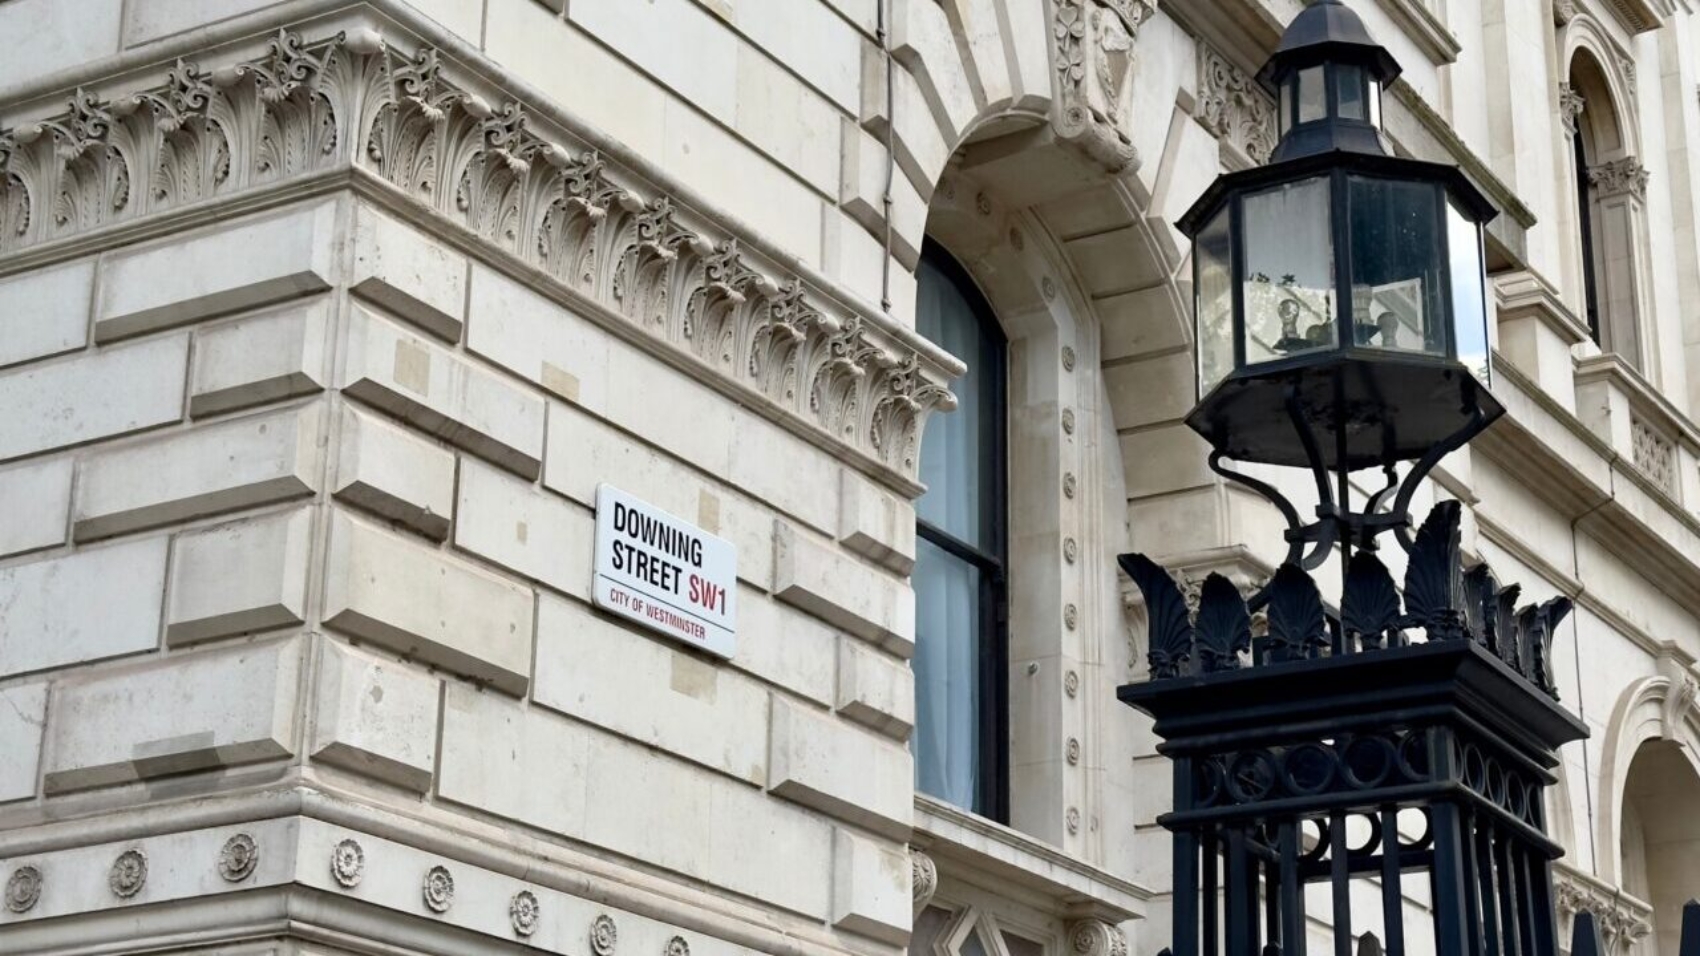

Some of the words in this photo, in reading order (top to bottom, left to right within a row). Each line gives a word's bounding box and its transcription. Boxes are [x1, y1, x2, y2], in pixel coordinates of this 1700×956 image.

[614, 501, 702, 568] DOWNING
[612, 540, 682, 595] STREET
[689, 574, 726, 616] SW1
[610, 588, 630, 607] CITY
[632, 597, 643, 613] OF
[646, 605, 706, 640] WESTMINSTER
